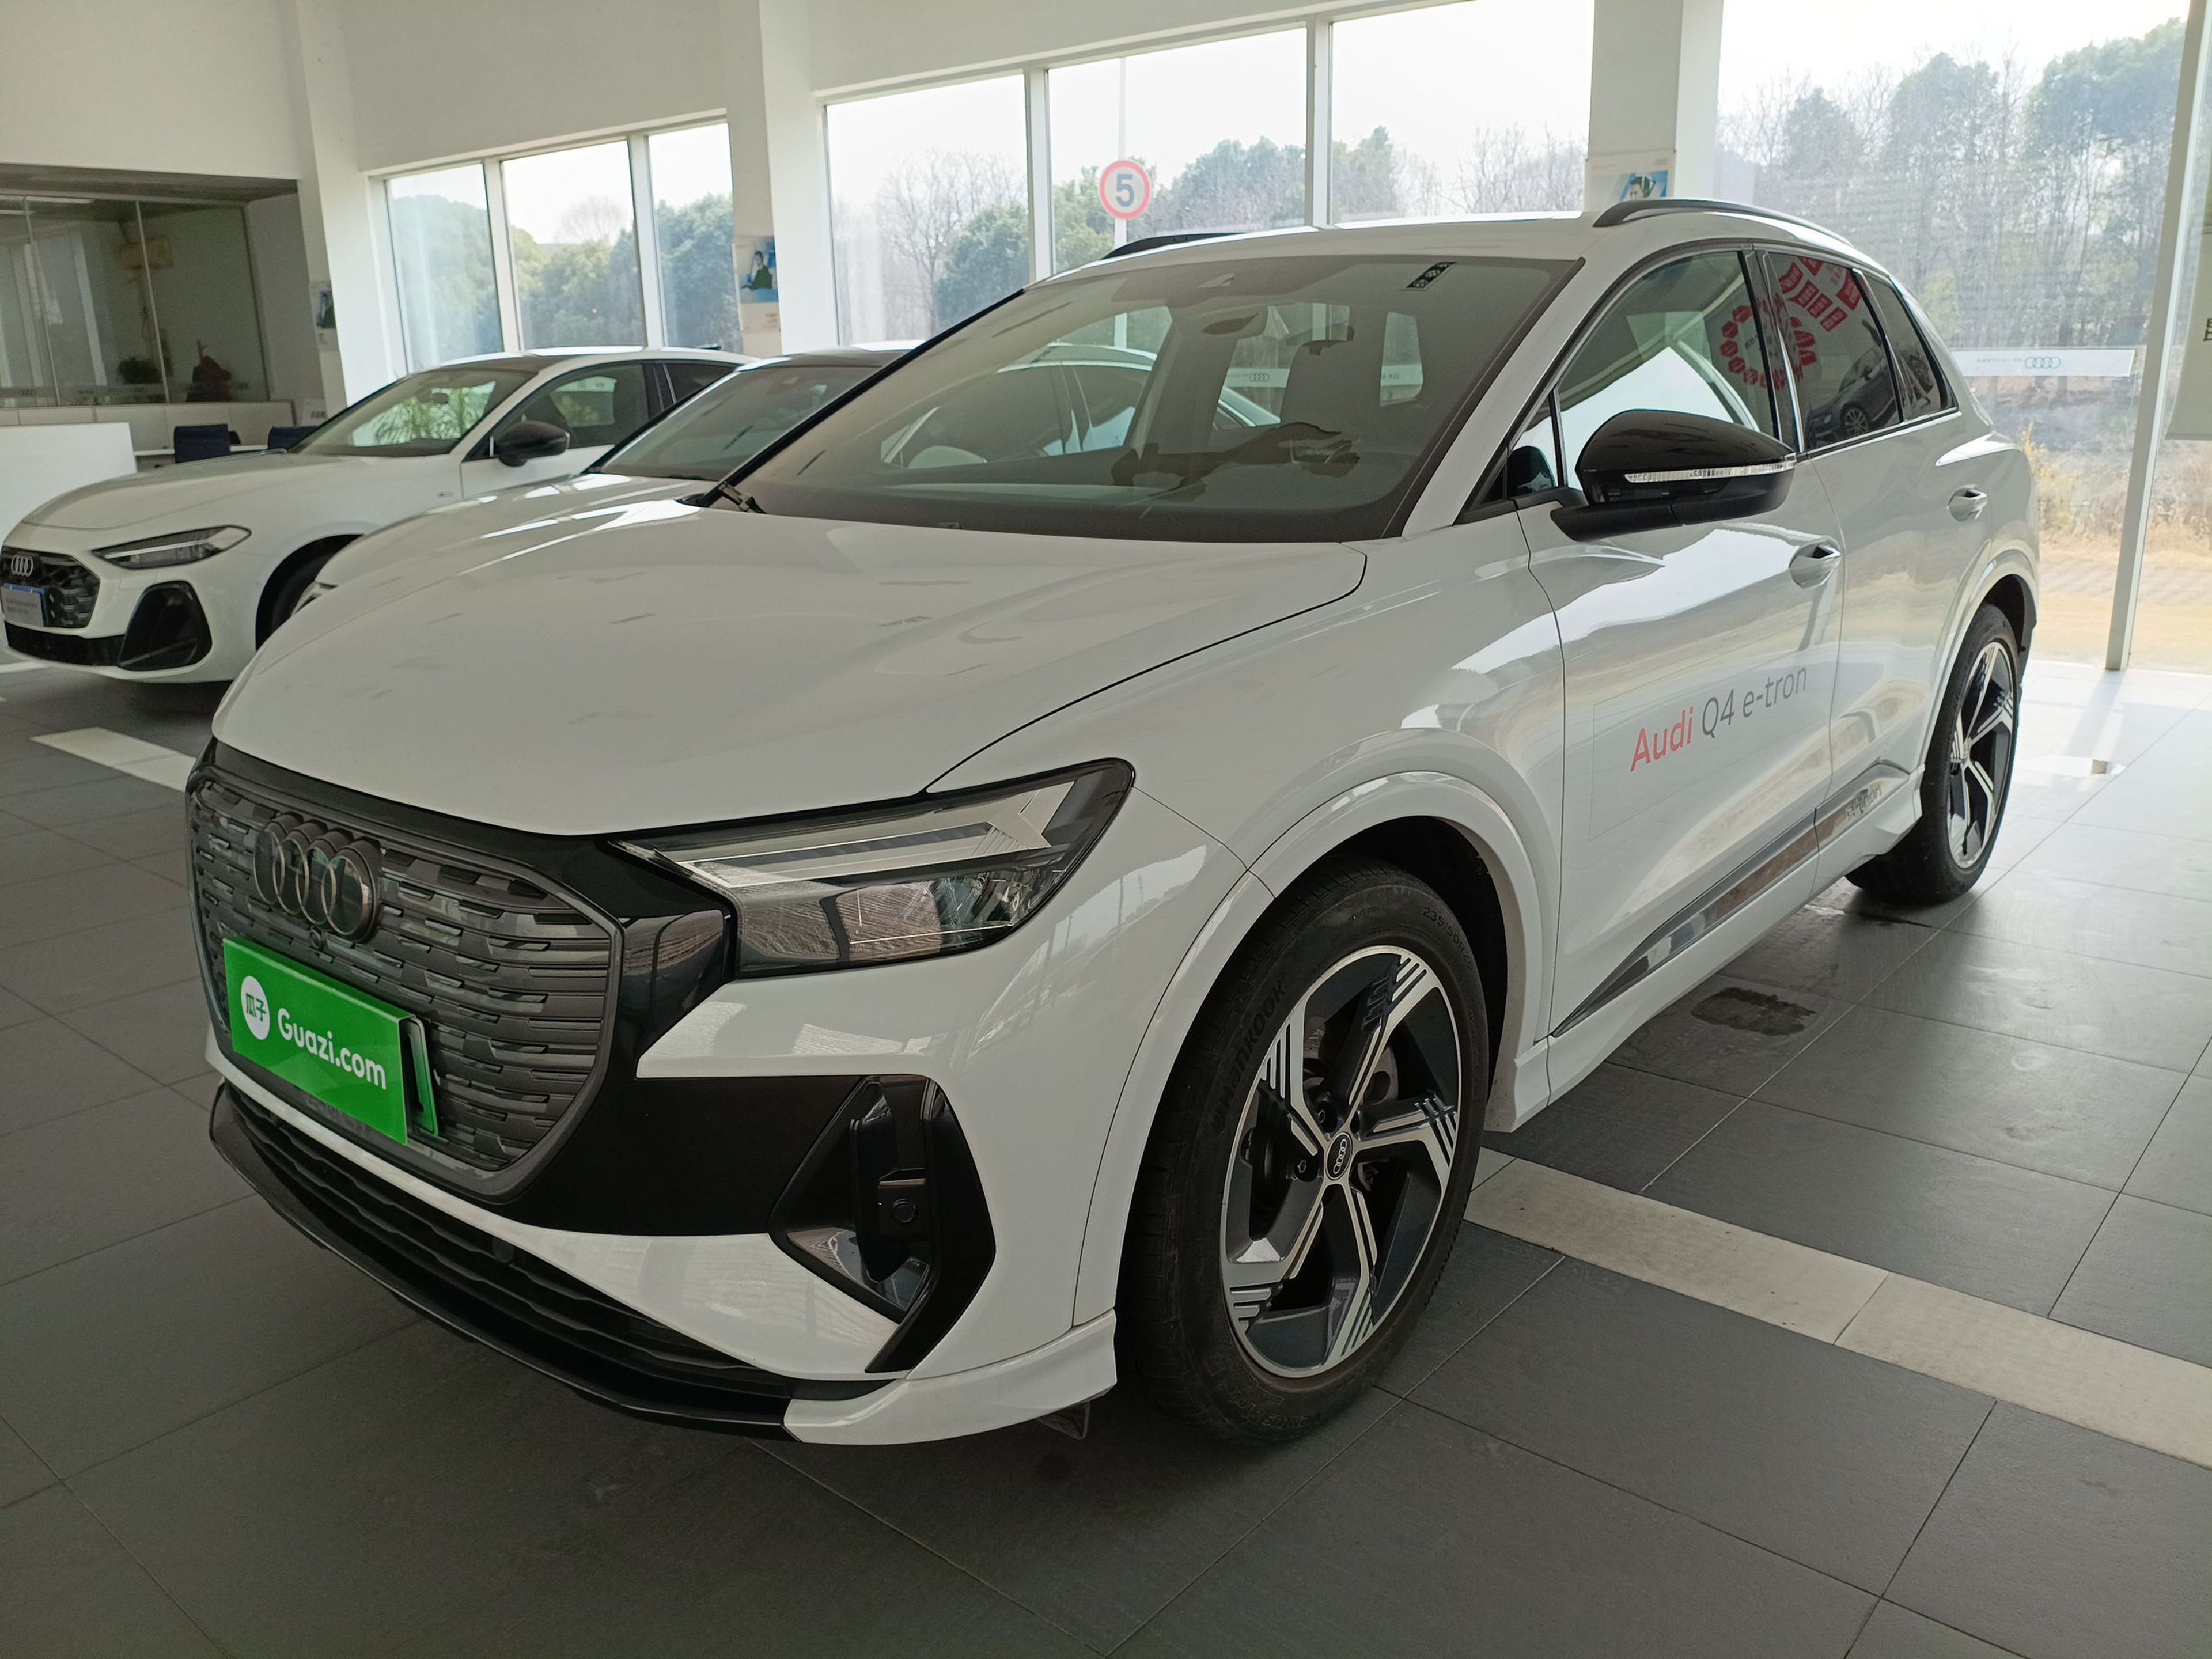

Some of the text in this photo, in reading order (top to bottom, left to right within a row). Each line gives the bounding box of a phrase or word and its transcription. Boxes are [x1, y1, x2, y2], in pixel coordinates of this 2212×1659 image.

[1116, 173, 1134, 207] 5
[1630, 666, 1808, 772] Audi Q4 e-tron
[245, 993, 267, 1022] 瓜子
[278, 1007, 387, 1090] Guazi.com
